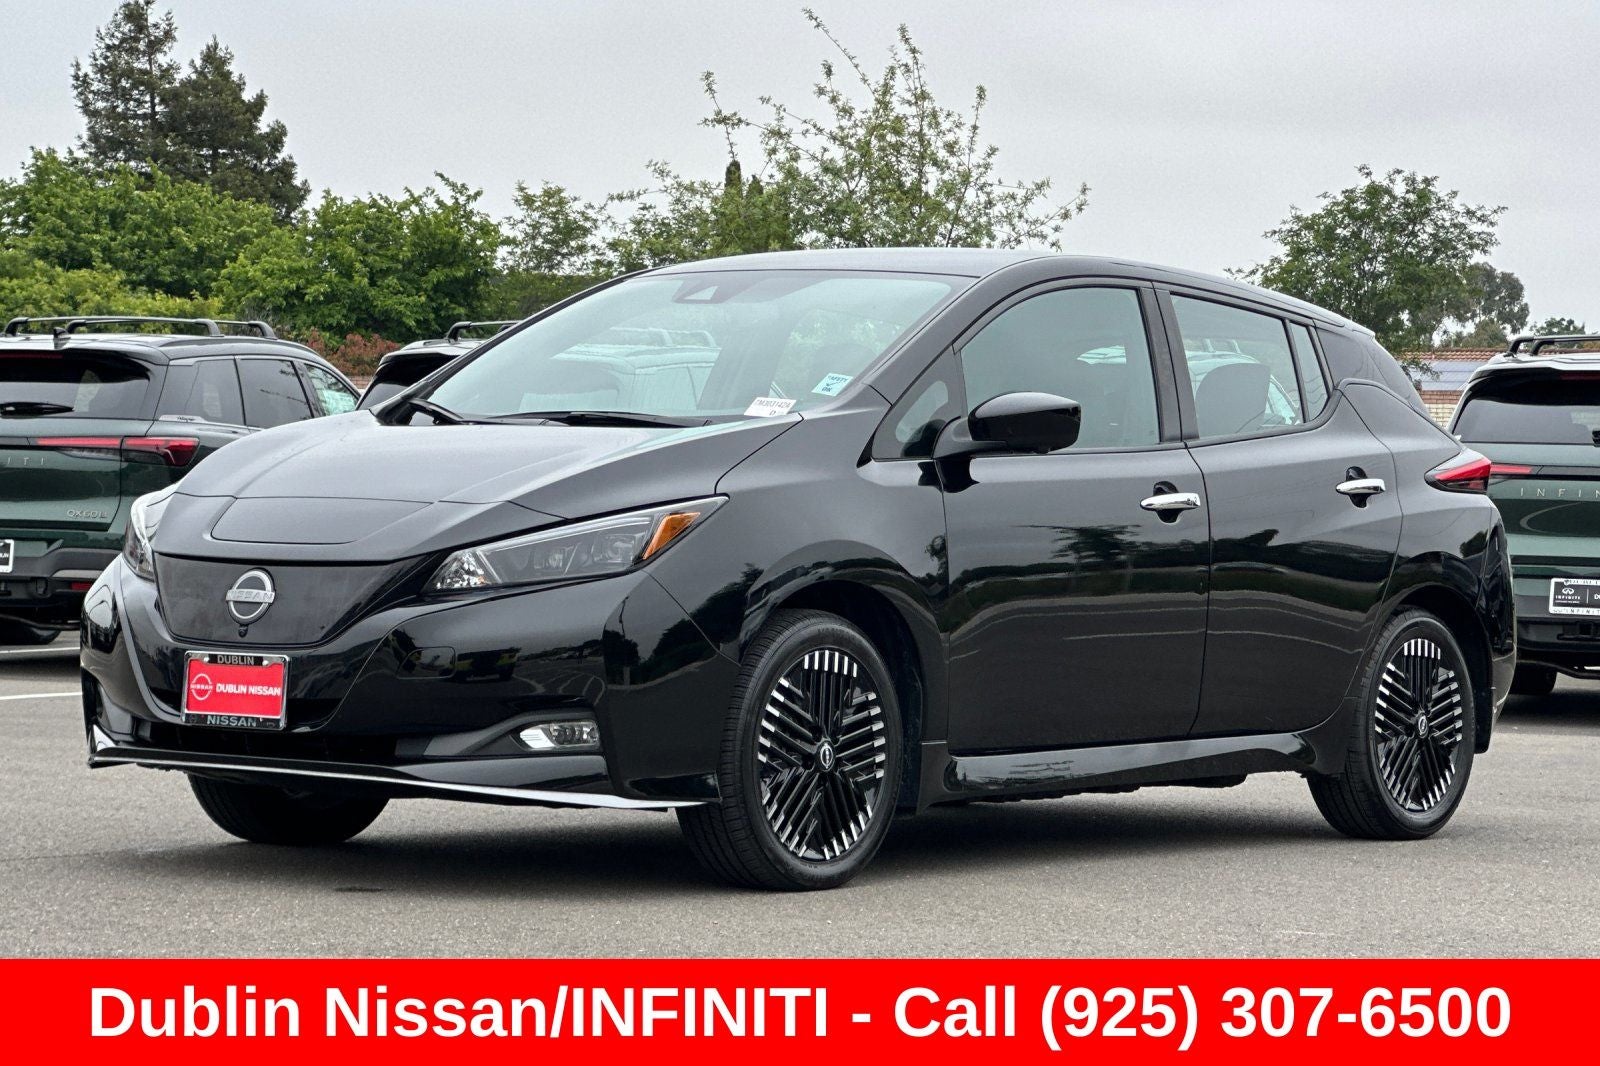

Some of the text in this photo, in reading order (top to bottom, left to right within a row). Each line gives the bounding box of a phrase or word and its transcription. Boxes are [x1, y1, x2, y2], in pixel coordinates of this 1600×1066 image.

[227, 590, 274, 601] NISSAN
[217, 654, 255, 666] DUBLIN
[216, 683, 281, 697] DUBLIN NISSAN
[206, 715, 257, 727] NISSAN
